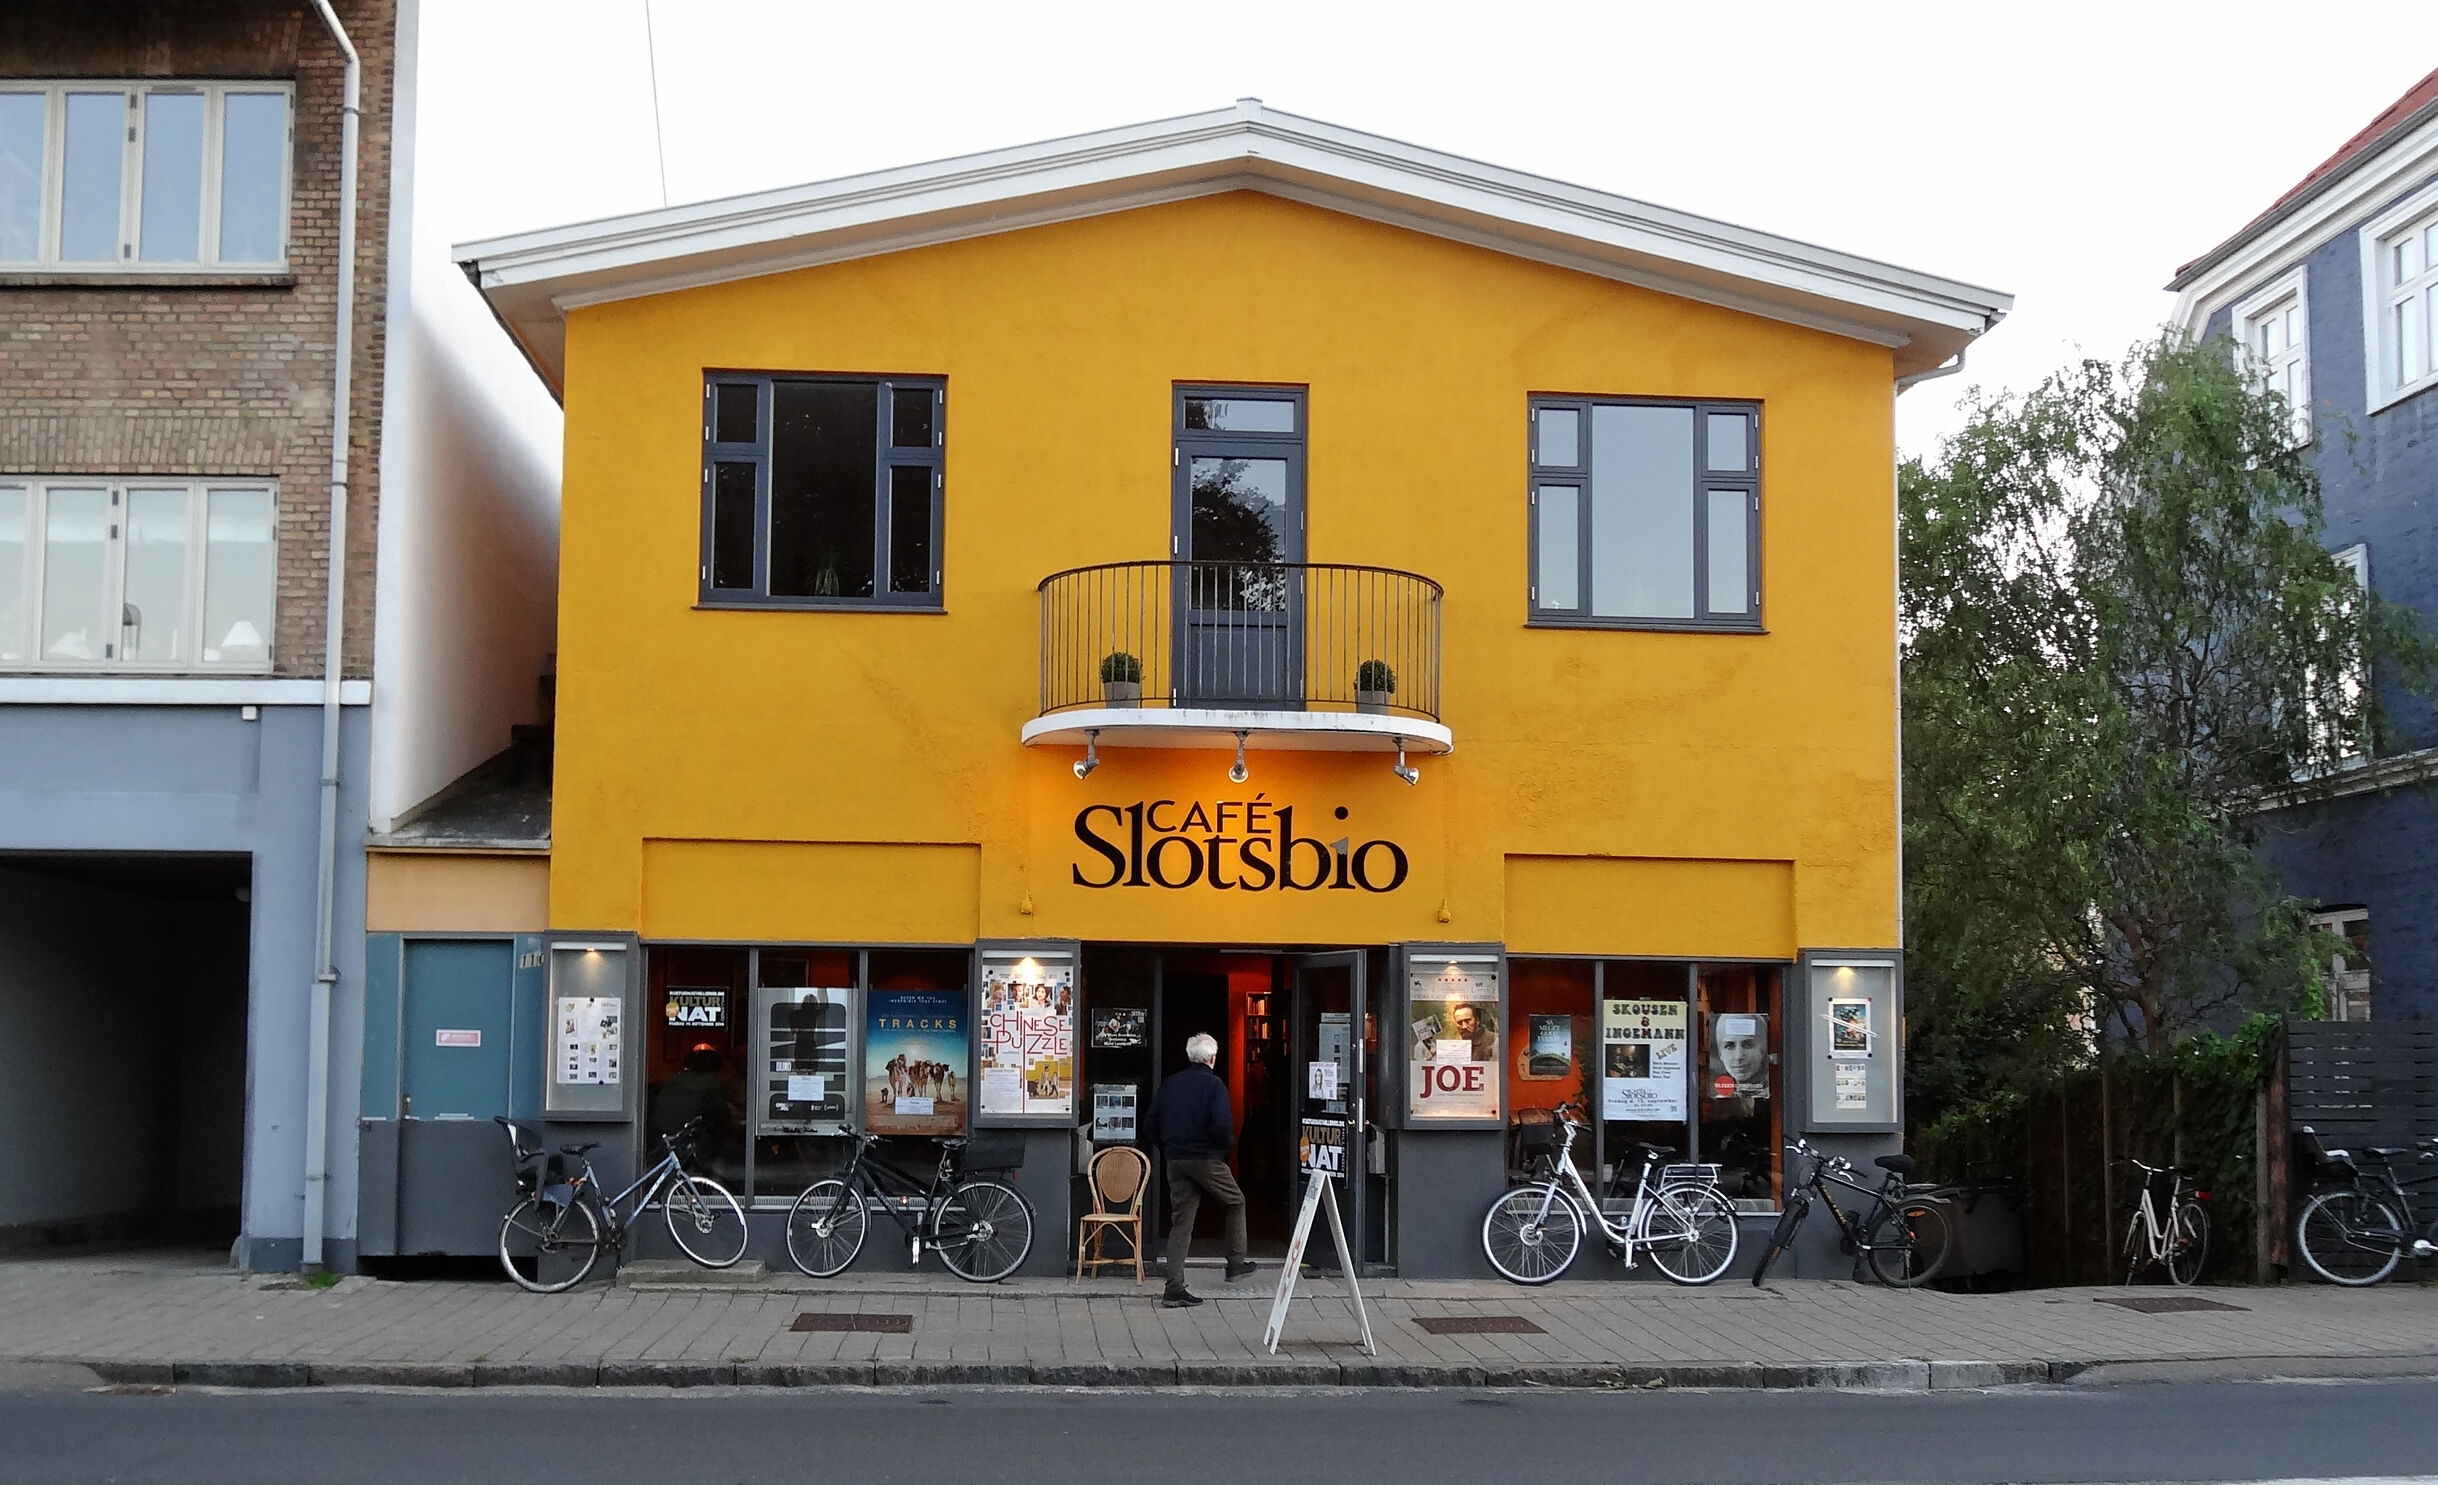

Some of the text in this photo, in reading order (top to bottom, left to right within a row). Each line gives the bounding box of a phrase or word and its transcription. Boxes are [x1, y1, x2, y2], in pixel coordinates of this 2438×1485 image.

[1146, 792, 1273, 834] CAFÉ
[1071, 799, 1410, 893] Slotsbio
[668, 995, 721, 1007] KULTUR
[1612, 1003, 1678, 1016] SKOUSEN
[668, 1006, 721, 1022] NAT
[1640, 1016, 1650, 1028] &
[878, 1018, 958, 1029] TRACKS
[981, 1030, 1068, 1055] PUZZLE
[1604, 1027, 1685, 1040] INGEMANN
[1655, 1042, 1678, 1060] LIVE
[1419, 1064, 1485, 1099] JOE
[1302, 1125, 1343, 1146] KULTUR
[1301, 1143, 1343, 1172] NAT
